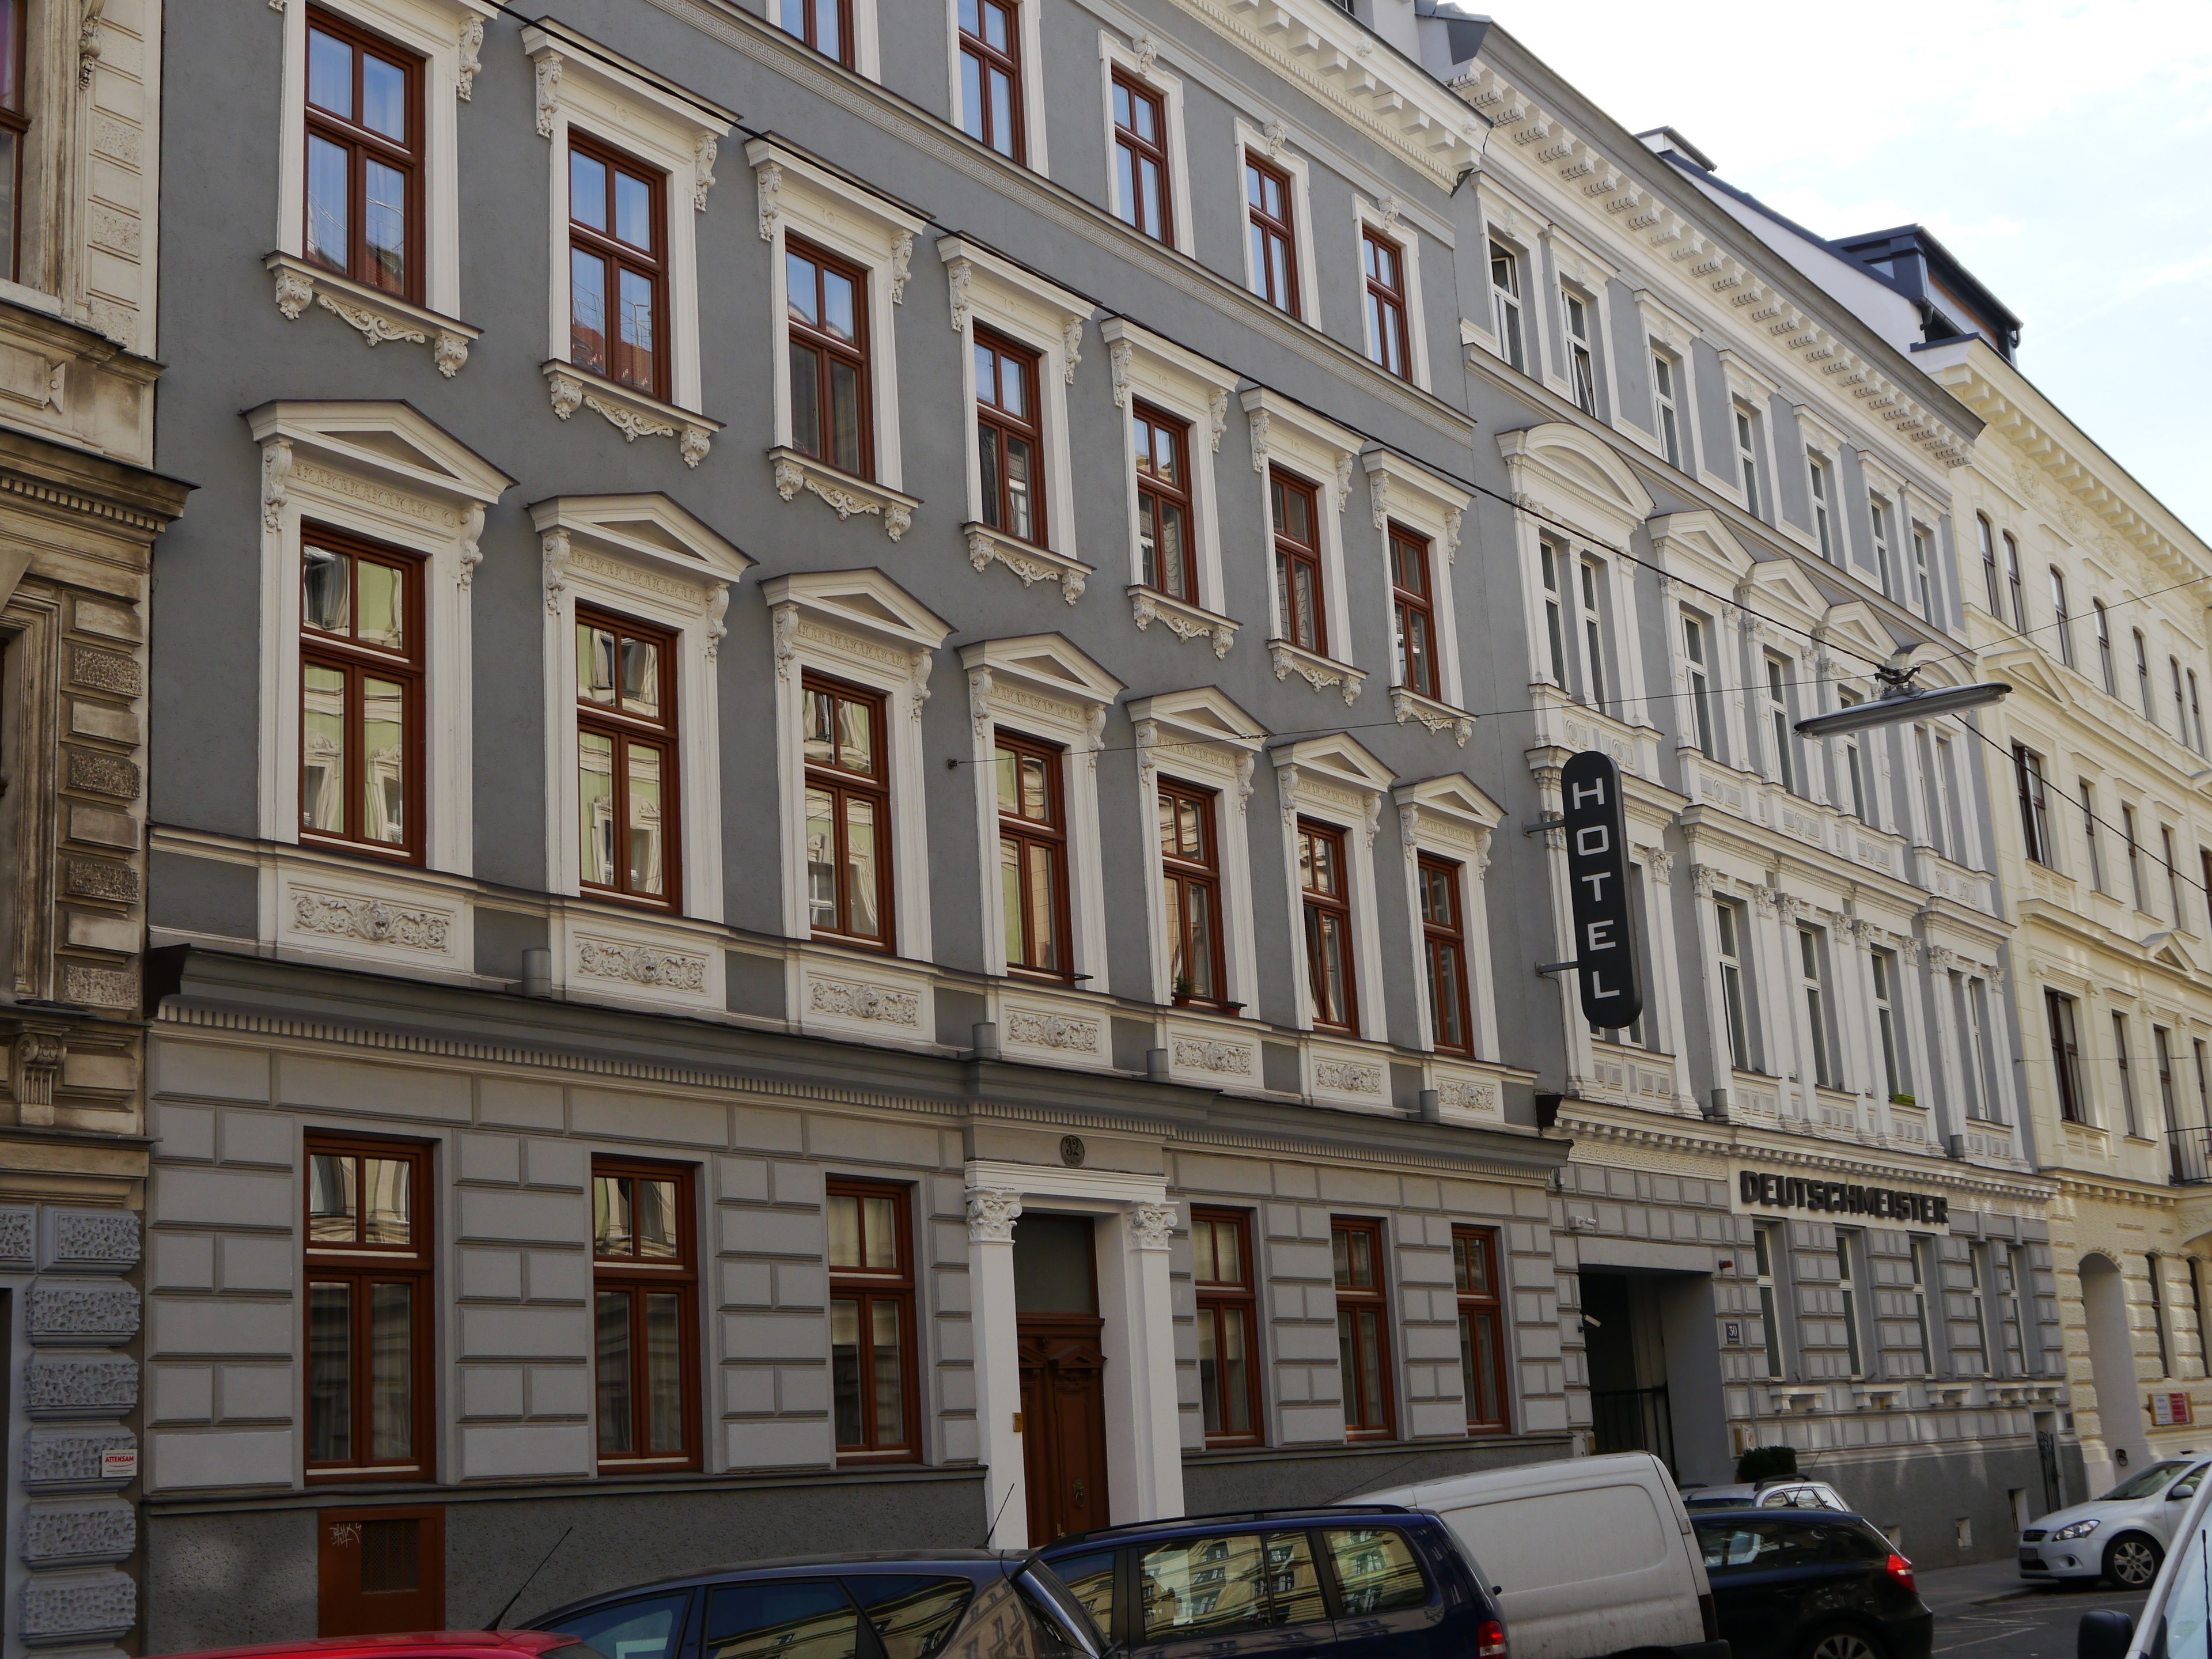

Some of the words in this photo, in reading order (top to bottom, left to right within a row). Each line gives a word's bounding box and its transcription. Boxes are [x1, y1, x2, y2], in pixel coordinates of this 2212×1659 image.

[1571, 777, 1620, 999] HOTEL
[1065, 1138, 1080, 1157] 32
[1740, 1170, 1949, 1224] DEUTSCHMEISTER
[1729, 1325, 1737, 1336] 30
